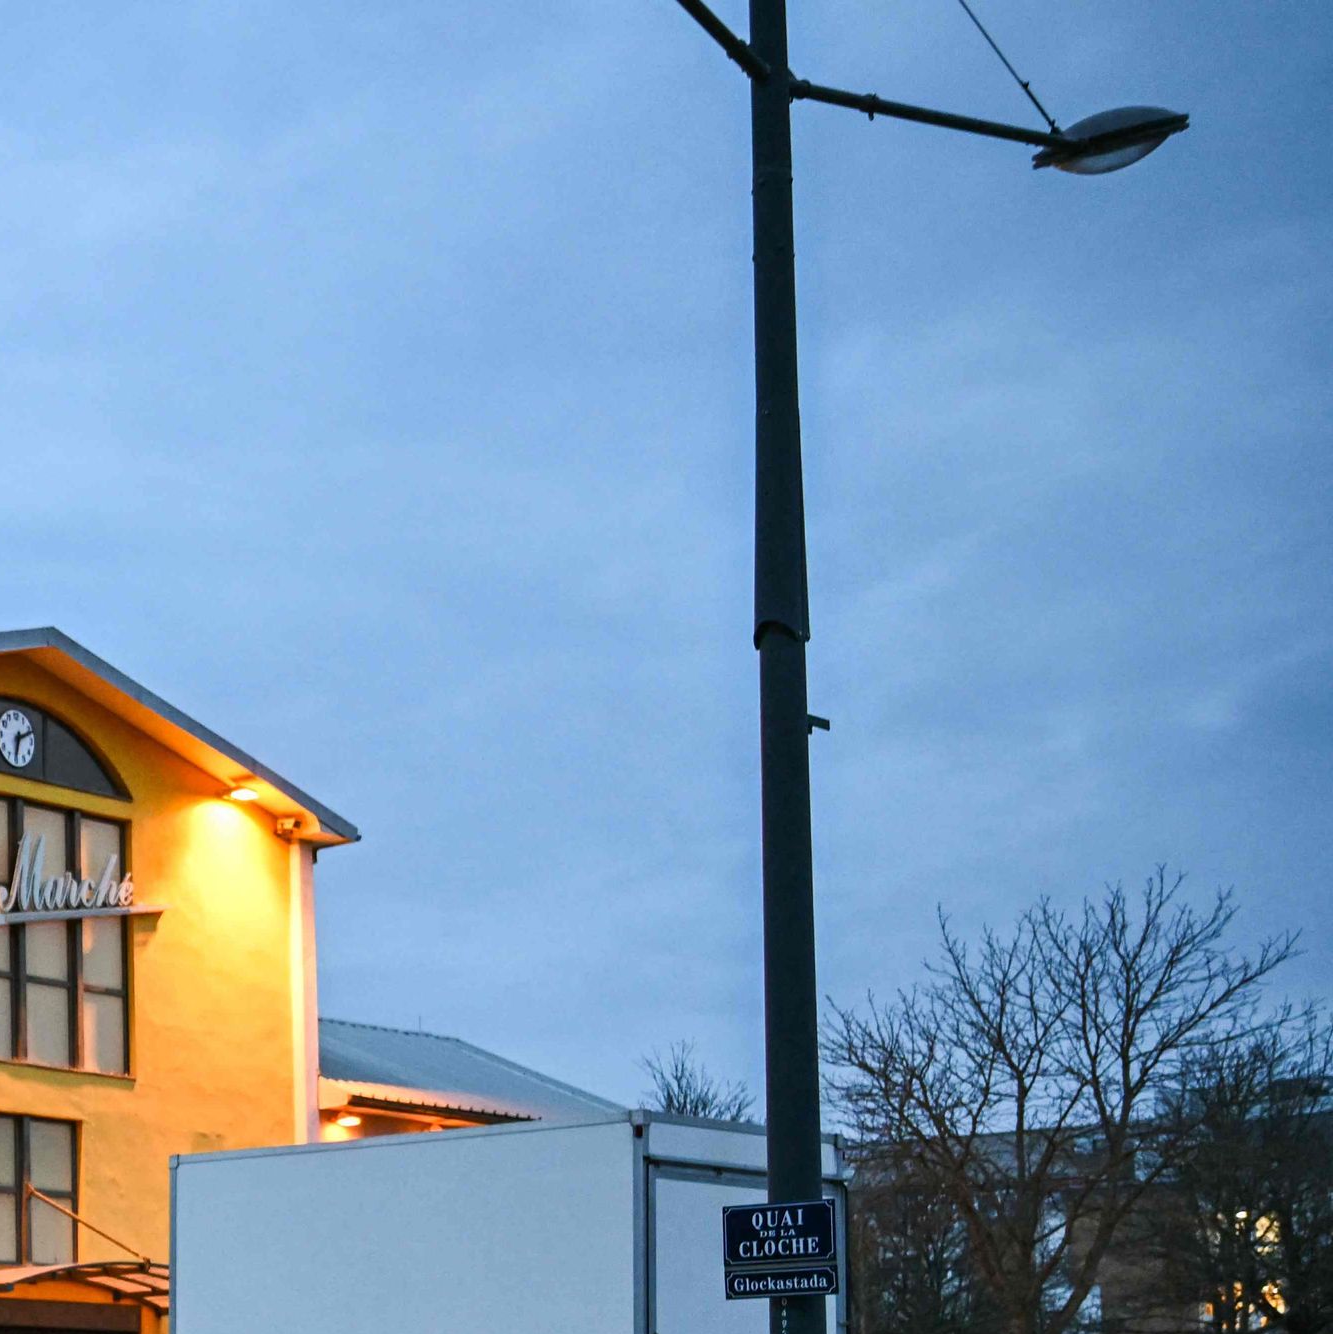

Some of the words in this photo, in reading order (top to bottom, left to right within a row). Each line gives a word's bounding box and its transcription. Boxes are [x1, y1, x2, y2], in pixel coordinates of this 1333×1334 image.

[751, 1208, 804, 1231] QUAI
[759, 1229, 776, 1238] DE
[780, 1228, 796, 1237] LA
[738, 1236, 819, 1258] CLOCHE
[734, 1274, 828, 1293] Glockastada
